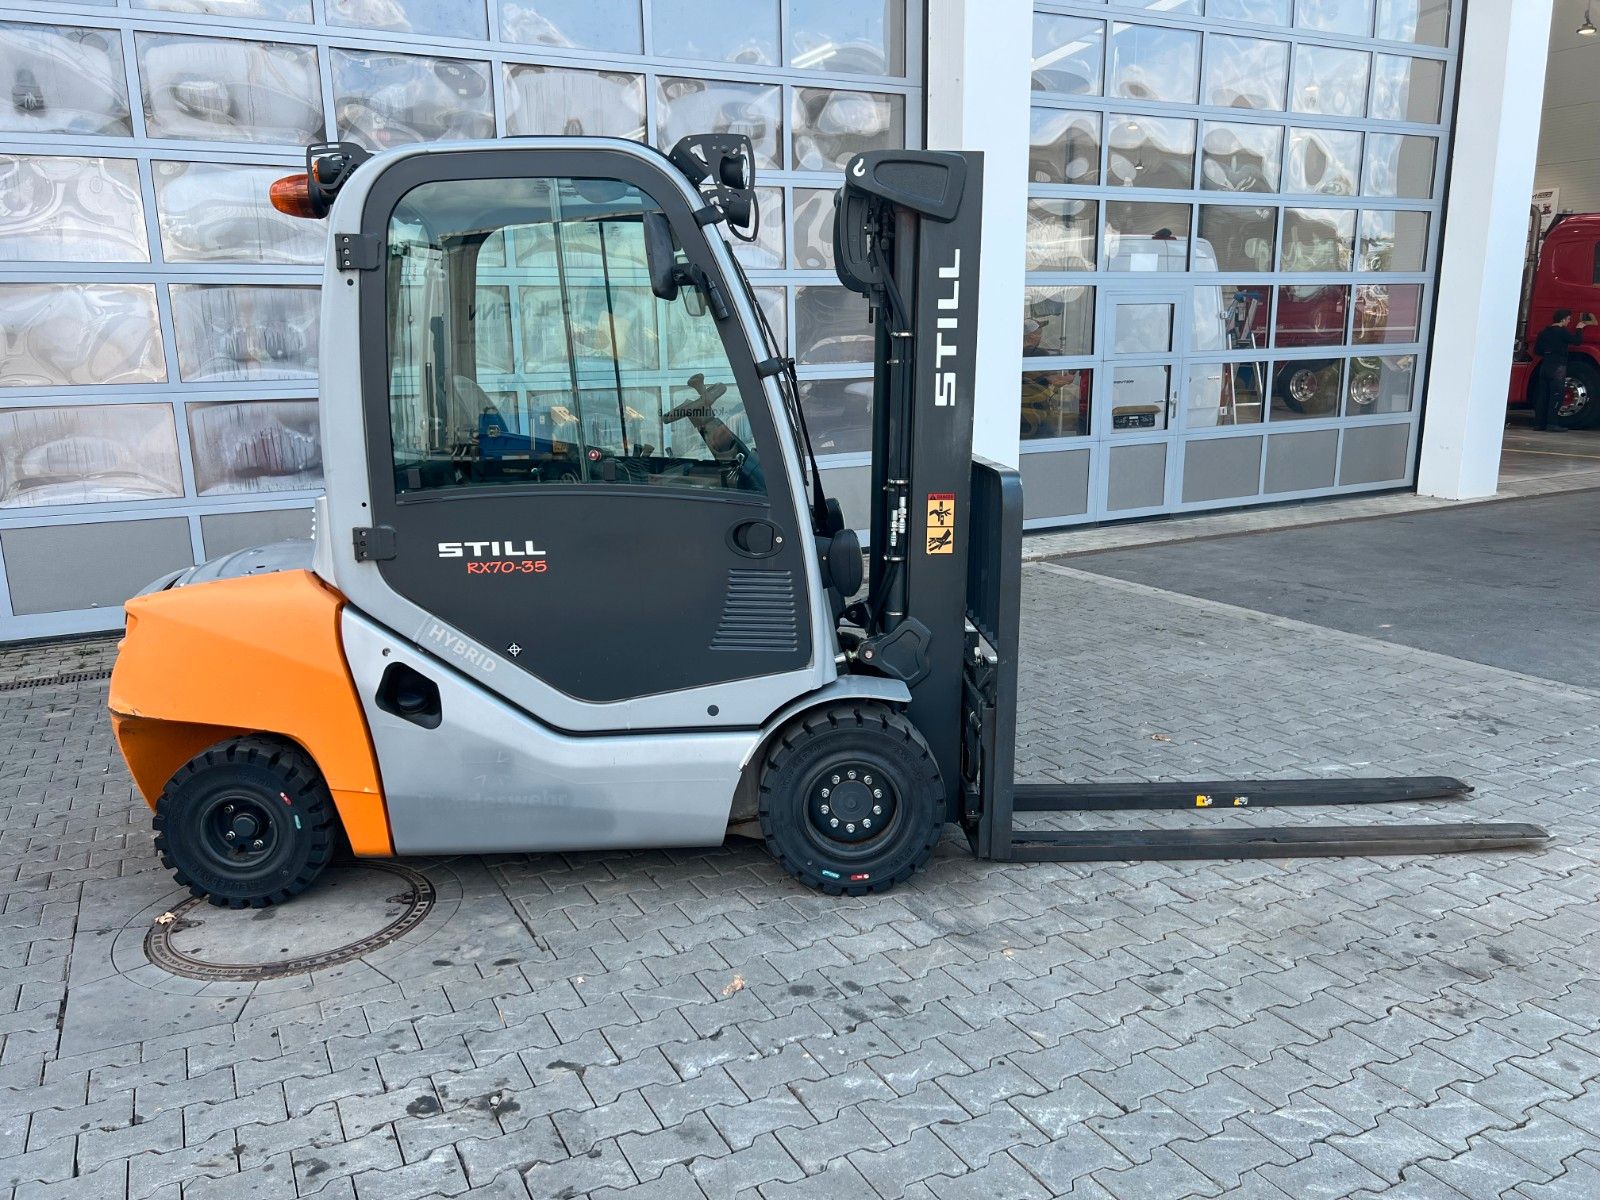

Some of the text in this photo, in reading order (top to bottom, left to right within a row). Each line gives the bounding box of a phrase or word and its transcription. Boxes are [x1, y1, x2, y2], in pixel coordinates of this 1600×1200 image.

[934, 248, 961, 407] STILL
[438, 541, 546, 557] STILL
[467, 560, 548, 574] RX70-35
[428, 624, 497, 672] HYBRID
